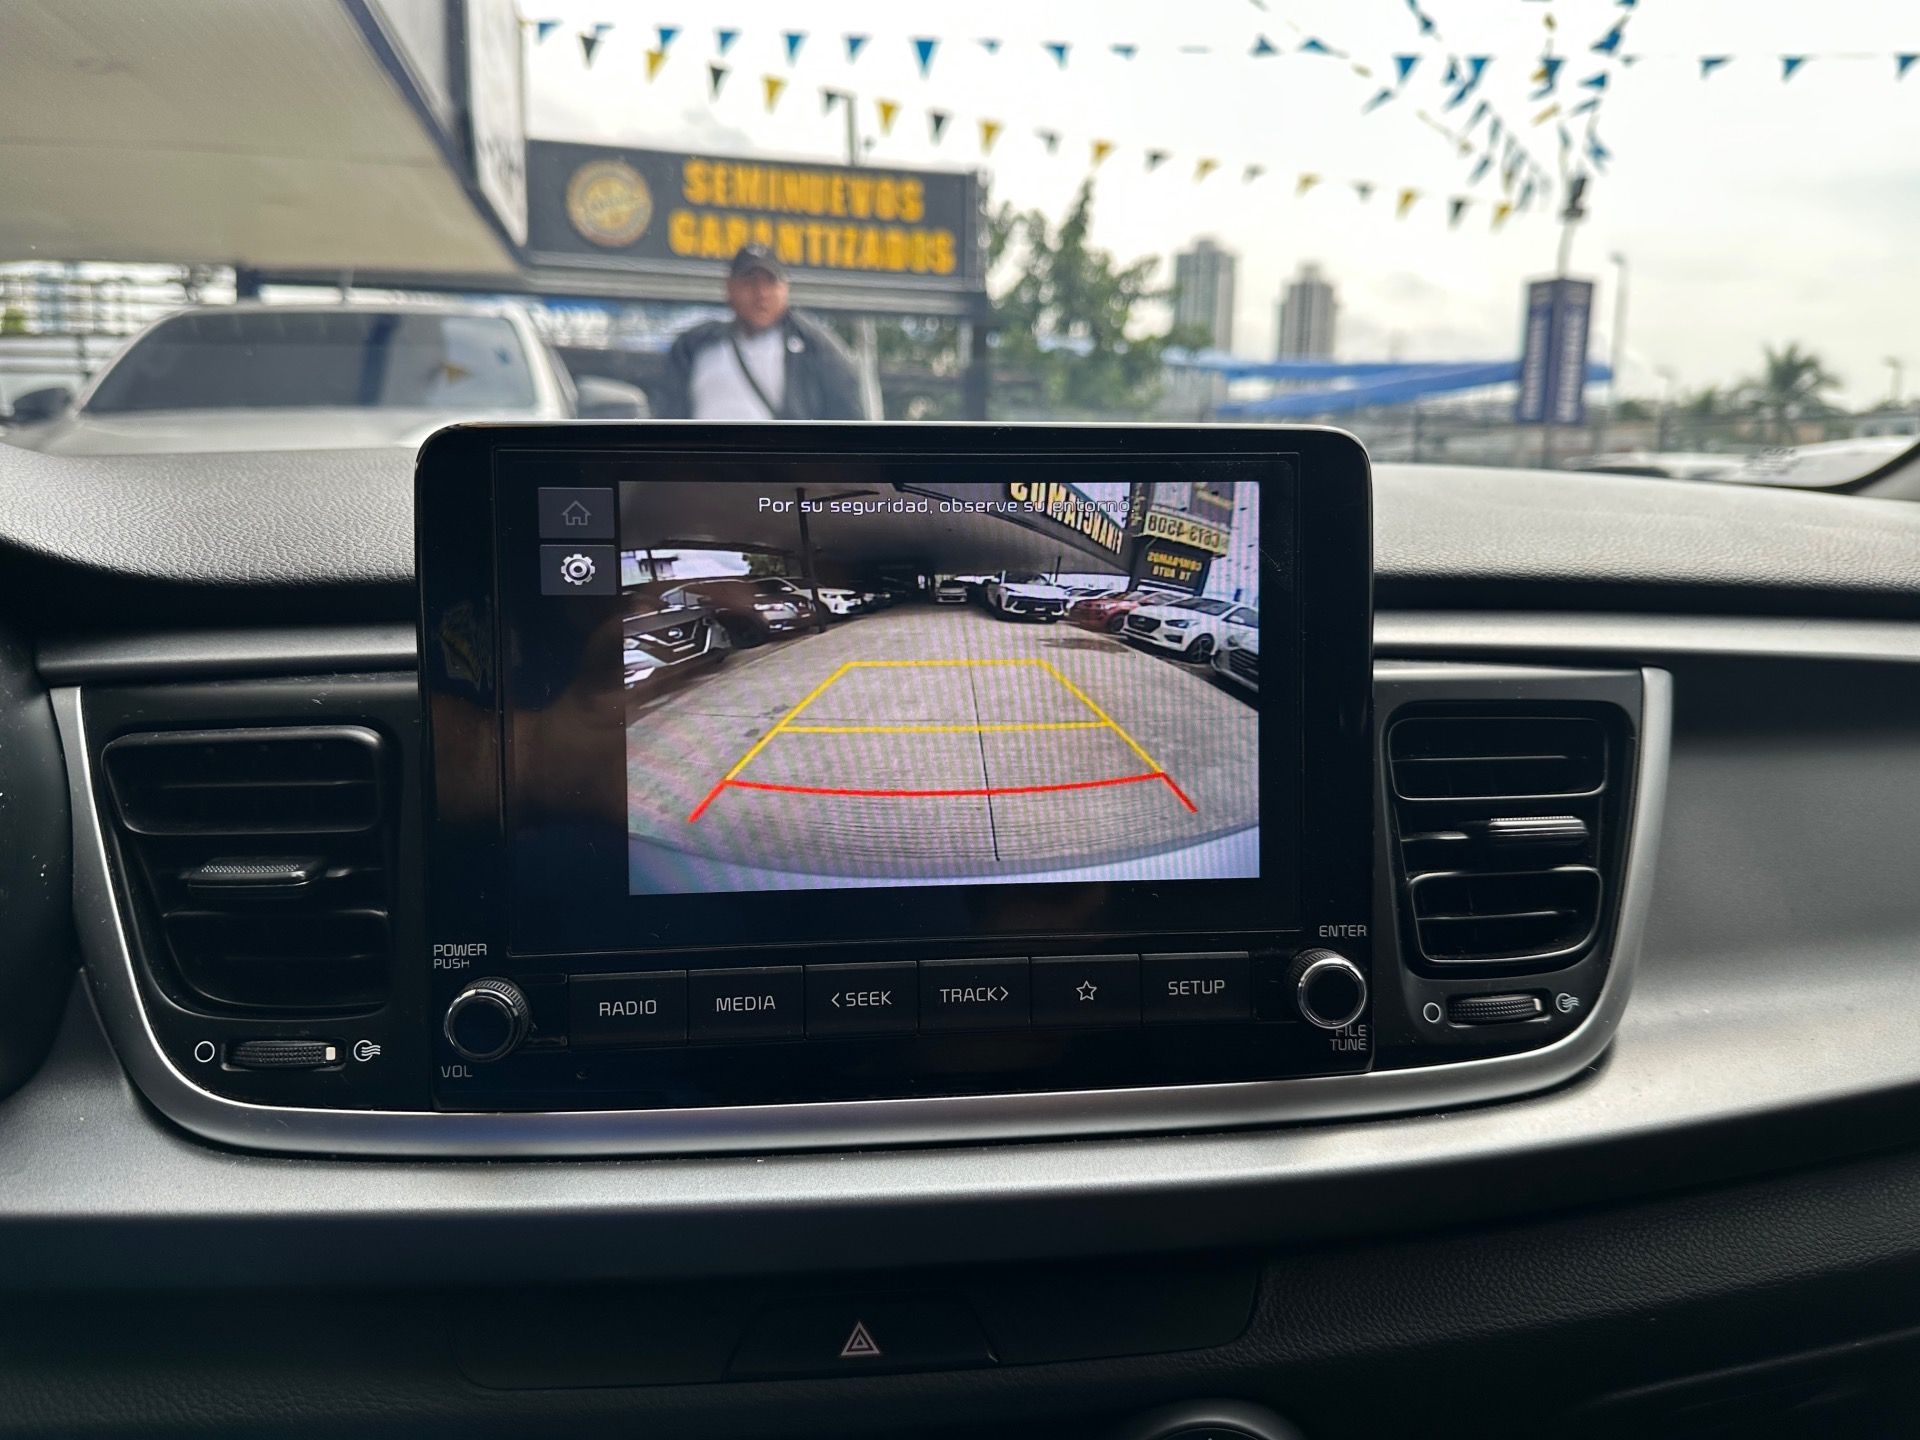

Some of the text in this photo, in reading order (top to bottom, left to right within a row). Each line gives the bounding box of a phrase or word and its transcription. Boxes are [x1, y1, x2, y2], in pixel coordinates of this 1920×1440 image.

[683, 159, 925, 223] SEMINUEVOS
[668, 210, 957, 275] GARANTIZADOS
[759, 497, 1135, 517] Por su seguridad, observe su entorno.
[1319, 924, 1367, 938] ENTER
[433, 943, 488, 957] POWER
[433, 959, 470, 969] PUSH
[1167, 979, 1226, 996] SETUP
[599, 999, 658, 1017] RADIO
[715, 995, 776, 1013] MEDIA
[1329, 1038, 1367, 1051] TUNE
[440, 1065, 473, 1079] VOL
